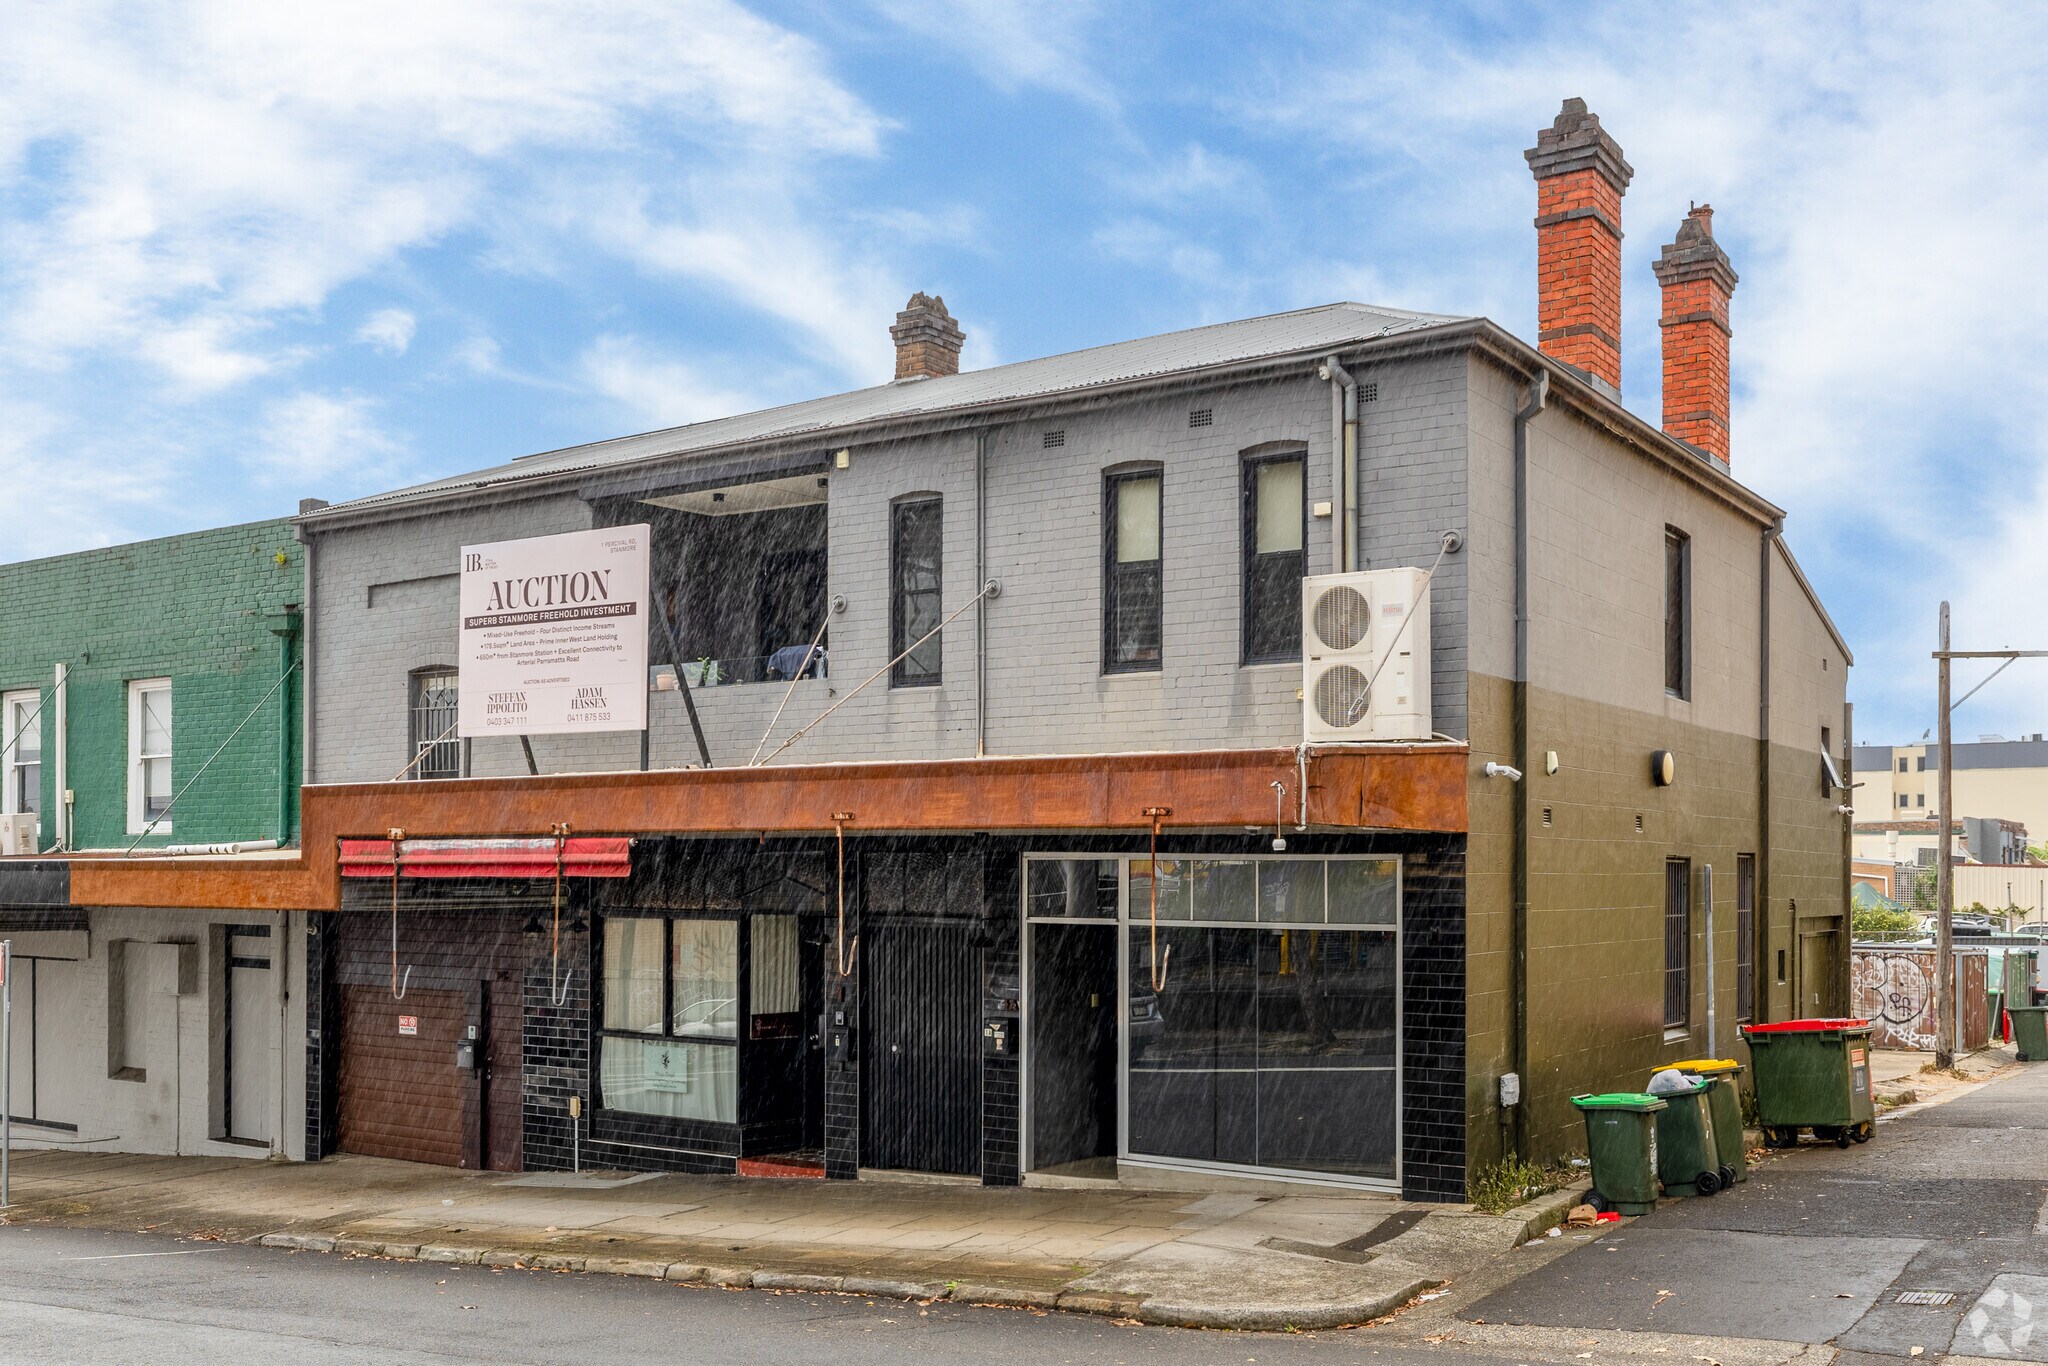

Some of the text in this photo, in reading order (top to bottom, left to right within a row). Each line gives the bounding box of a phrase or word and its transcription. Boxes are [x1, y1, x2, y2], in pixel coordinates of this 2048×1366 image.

[610, 545, 636, 554] STANMORE
[466, 554, 483, 572] IB.
[486, 570, 611, 610] AUCTION
[469, 604, 632, 627] SUPERB STANMORE FREEHOLD INVESTMENT
[597, 633, 618, 641] Holding
[582, 645, 616, 653] Connectivity
[488, 691, 526, 703] STEFFAN
[576, 687, 603, 698] ADAM
[487, 702, 528, 714] IPPOLITO
[571, 698, 607, 709] HASSEN
[503, 717, 514, 725] 347
[516, 716, 527, 724] 111
[567, 712, 611, 722] 0411 875 533
[400, 1017, 408, 1025] NO
